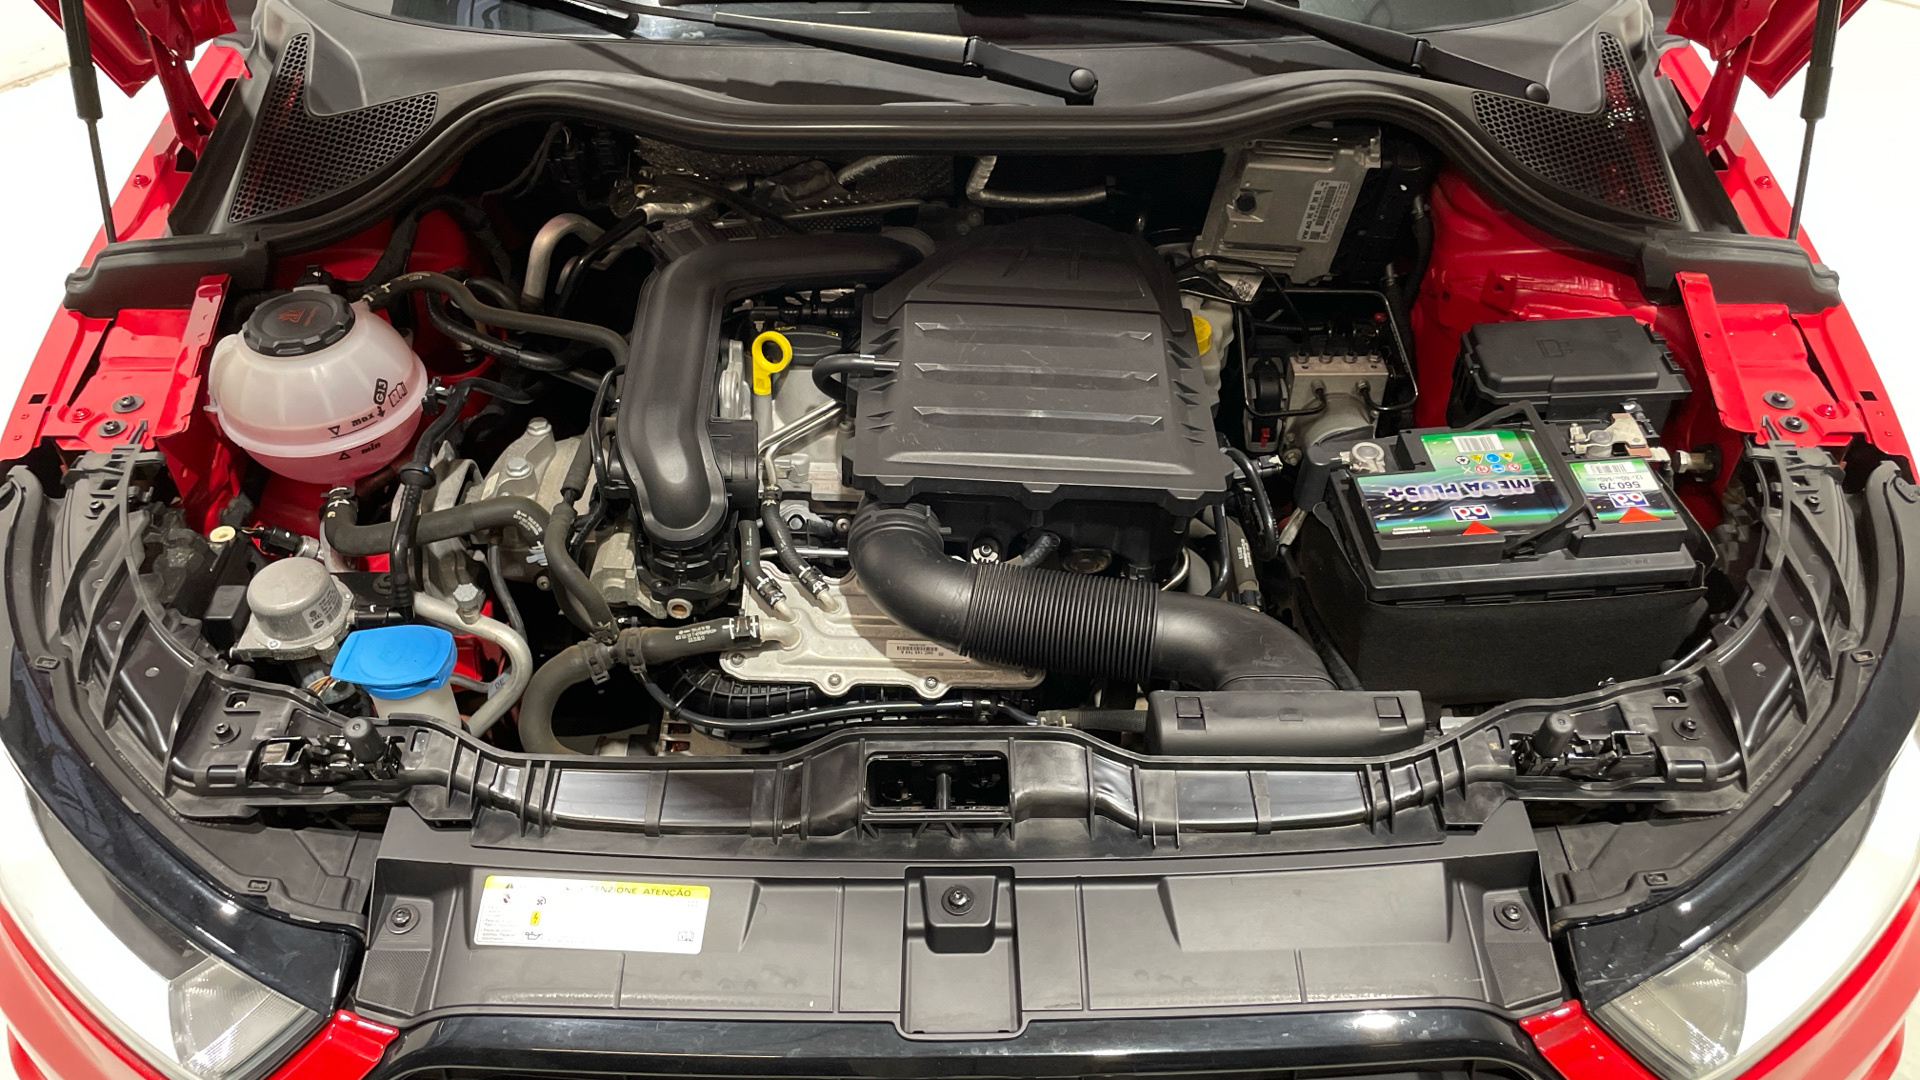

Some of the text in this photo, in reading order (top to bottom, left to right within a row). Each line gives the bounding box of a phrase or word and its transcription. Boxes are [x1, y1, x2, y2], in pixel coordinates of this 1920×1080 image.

[375, 381, 387, 402] G13
[351, 412, 375, 427] max
[361, 442, 381, 454] min
[1465, 478, 1535, 498] MEGA
[1598, 481, 1641, 491] 560.79
[588, 884, 691, 897] ENZIONE ATENÇÃO
